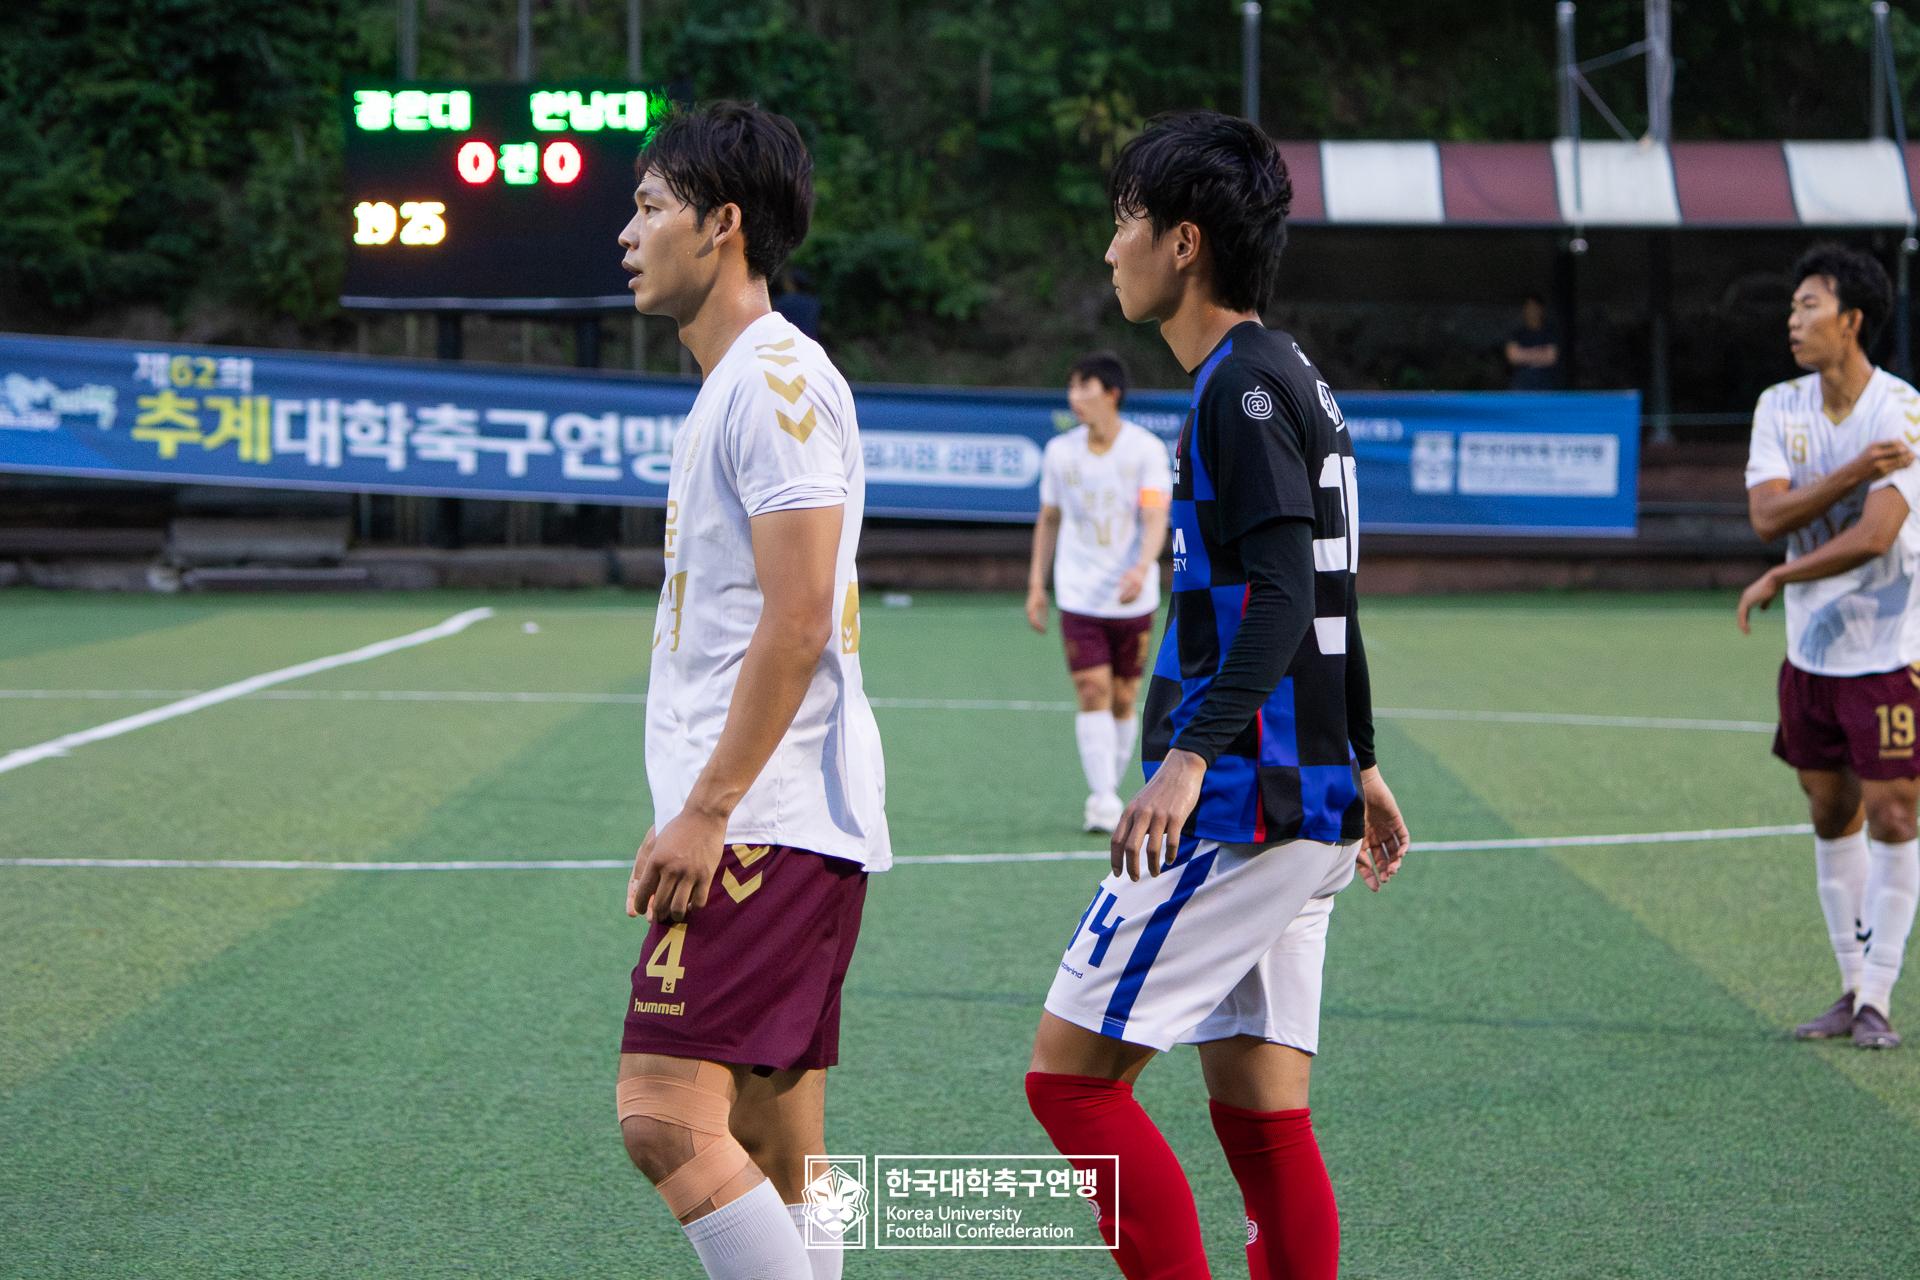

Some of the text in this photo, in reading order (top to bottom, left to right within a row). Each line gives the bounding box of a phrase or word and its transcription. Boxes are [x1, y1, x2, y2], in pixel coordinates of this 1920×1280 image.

[457, 141, 496, 184] 0
[543, 141, 582, 184] 0
[132, 351, 254, 393] 제62회
[1875, 703, 1917, 748] 19
[646, 922, 689, 994] 4
[634, 997, 686, 1017] hummel
